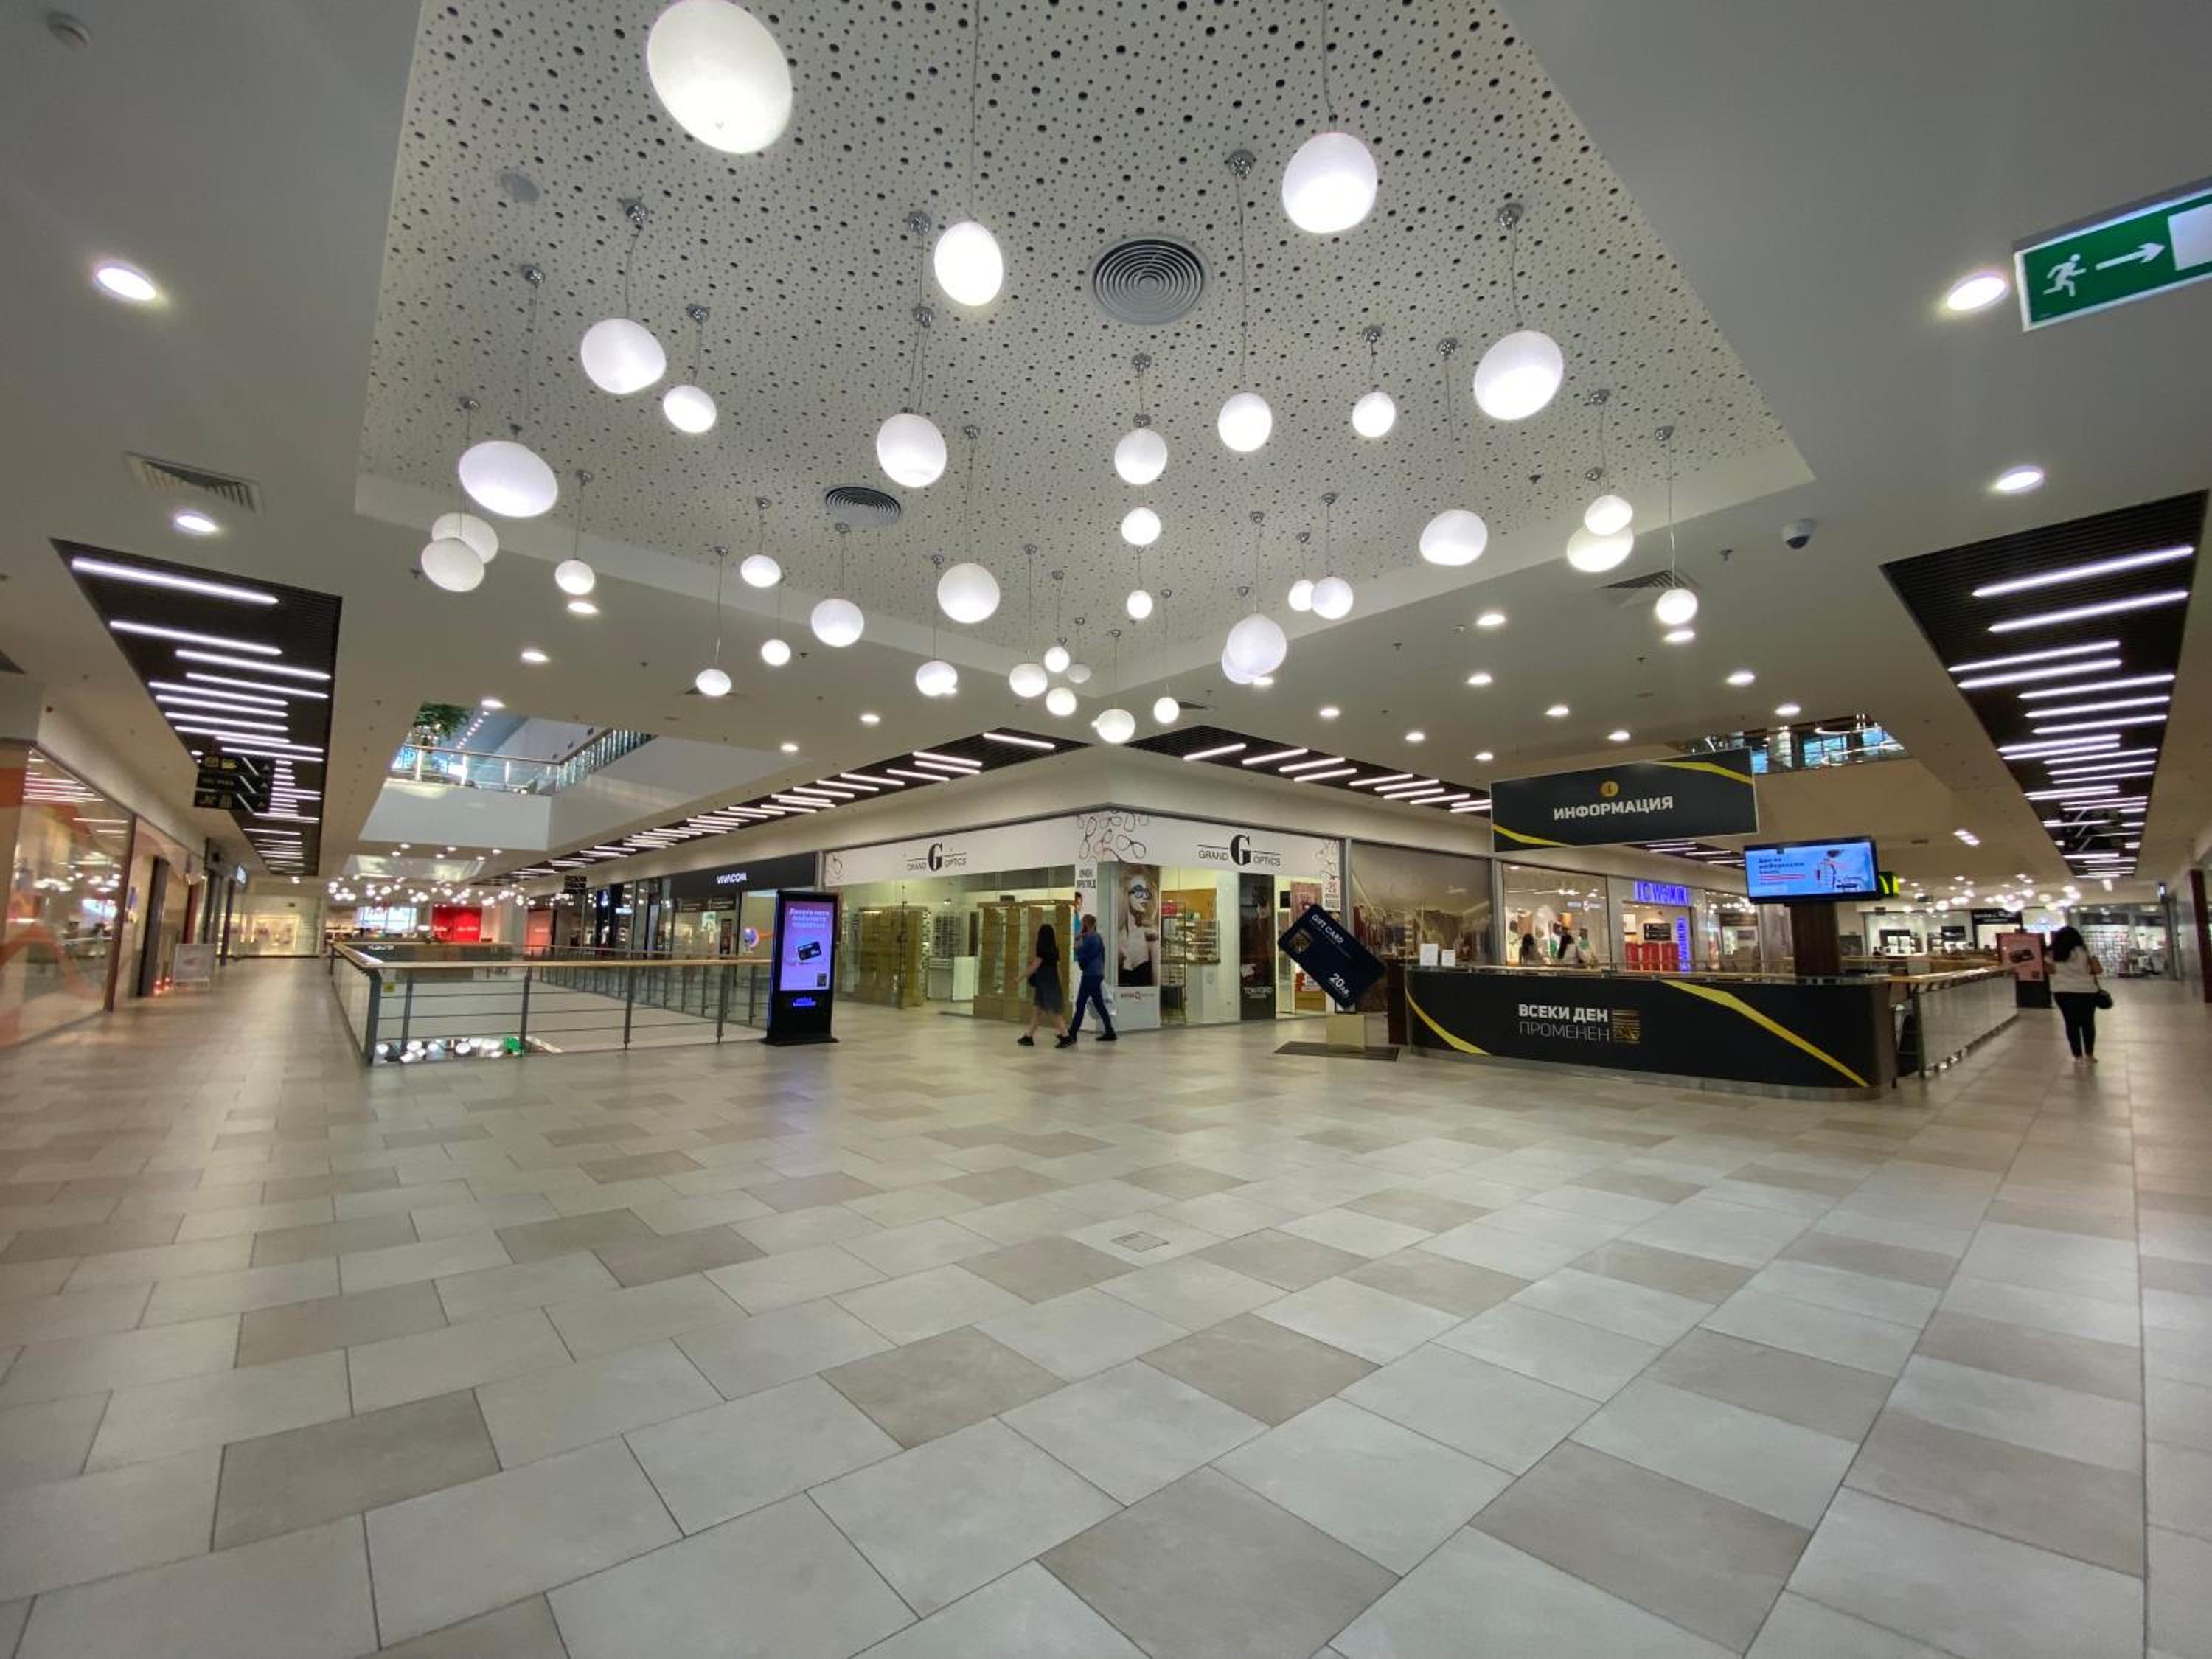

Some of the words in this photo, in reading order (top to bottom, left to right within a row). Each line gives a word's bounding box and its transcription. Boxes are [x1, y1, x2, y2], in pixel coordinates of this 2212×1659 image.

[1554, 796, 1673, 821] ИНФОРМАЦИЯ
[1198, 850, 1229, 861] GRAND
[1253, 855, 1281, 866] OPTICS
[716, 872, 747, 884] VIVACOM
[1312, 914, 1327, 928] GIFT
[1324, 927, 1345, 945] CARD
[1518, 1004, 1570, 1020] ВСЕКИ
[1573, 1007, 1609, 1023] ДЕН
[1519, 1021, 1610, 1042] ПРОМЕНЕН
